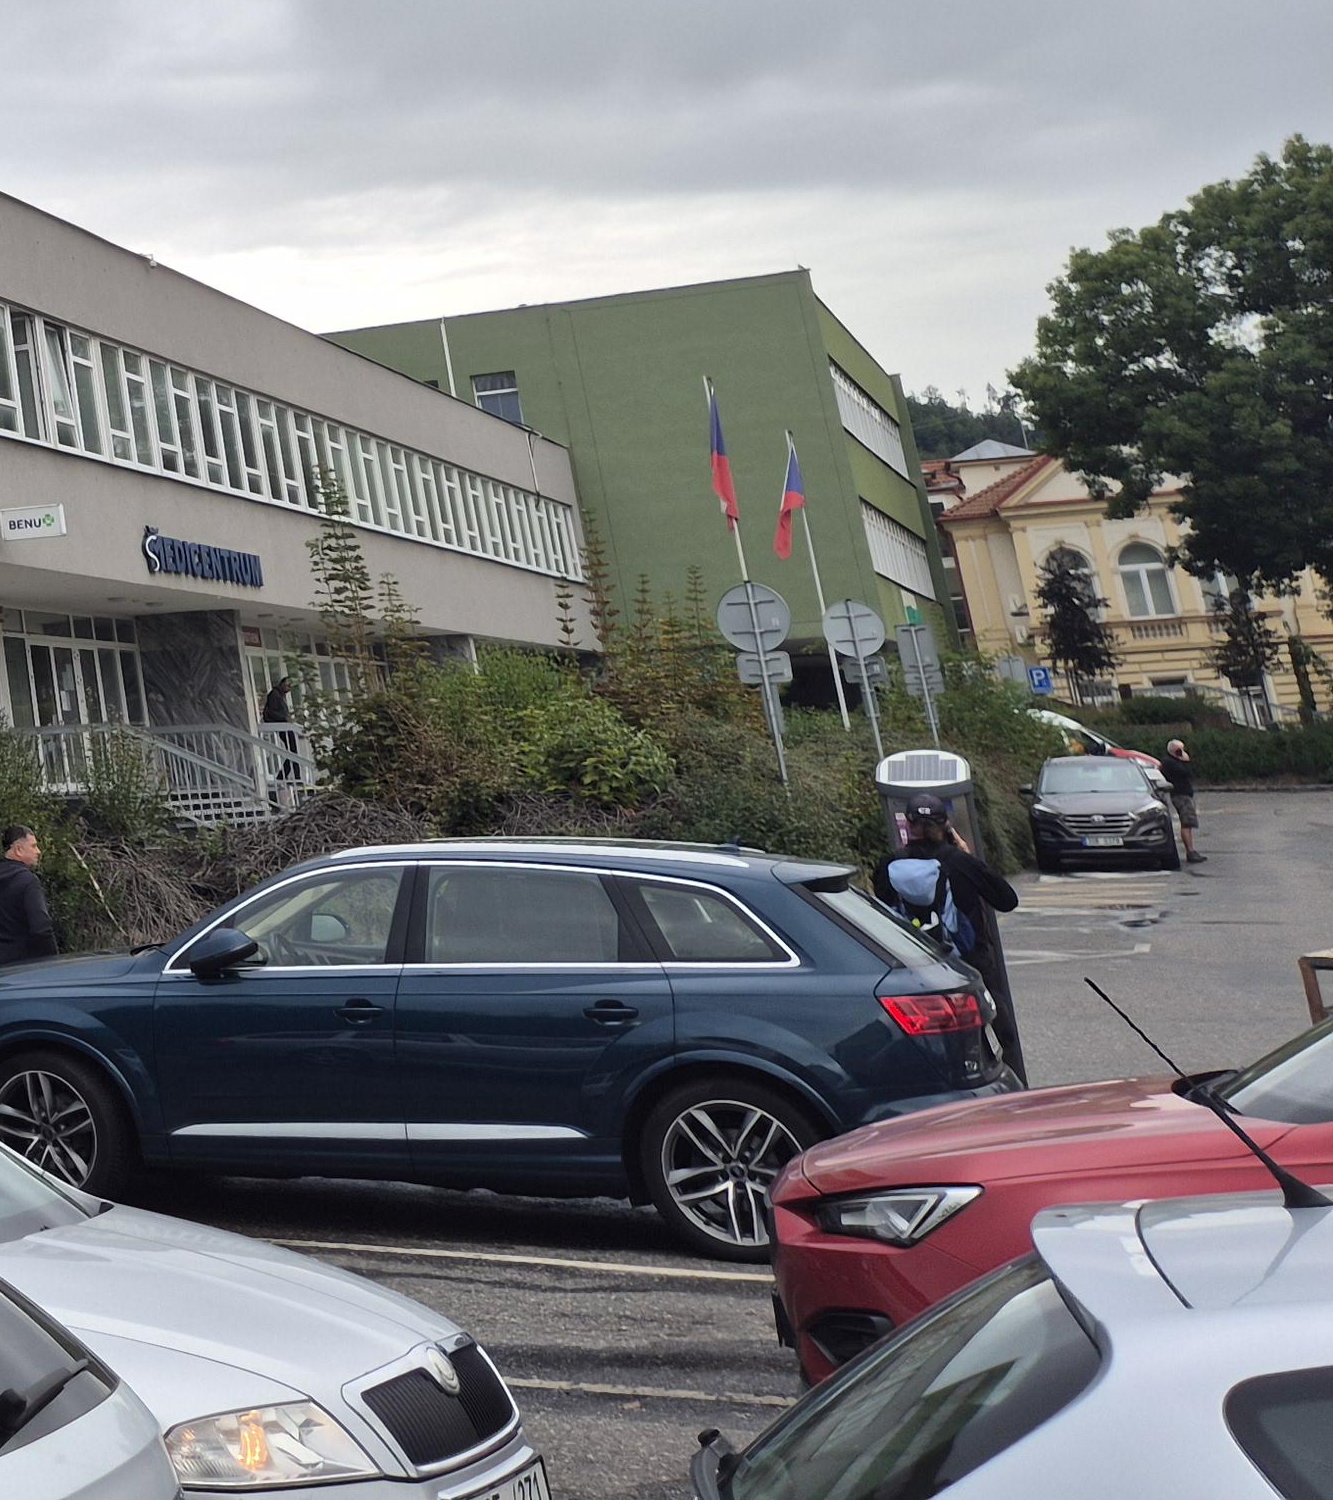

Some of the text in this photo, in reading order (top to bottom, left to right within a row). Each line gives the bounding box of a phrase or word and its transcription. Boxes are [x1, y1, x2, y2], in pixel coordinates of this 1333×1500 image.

[8, 518, 42, 531] BENU
[146, 534, 264, 588] MEDICENTRUM
[1032, 669, 1045, 686] P
